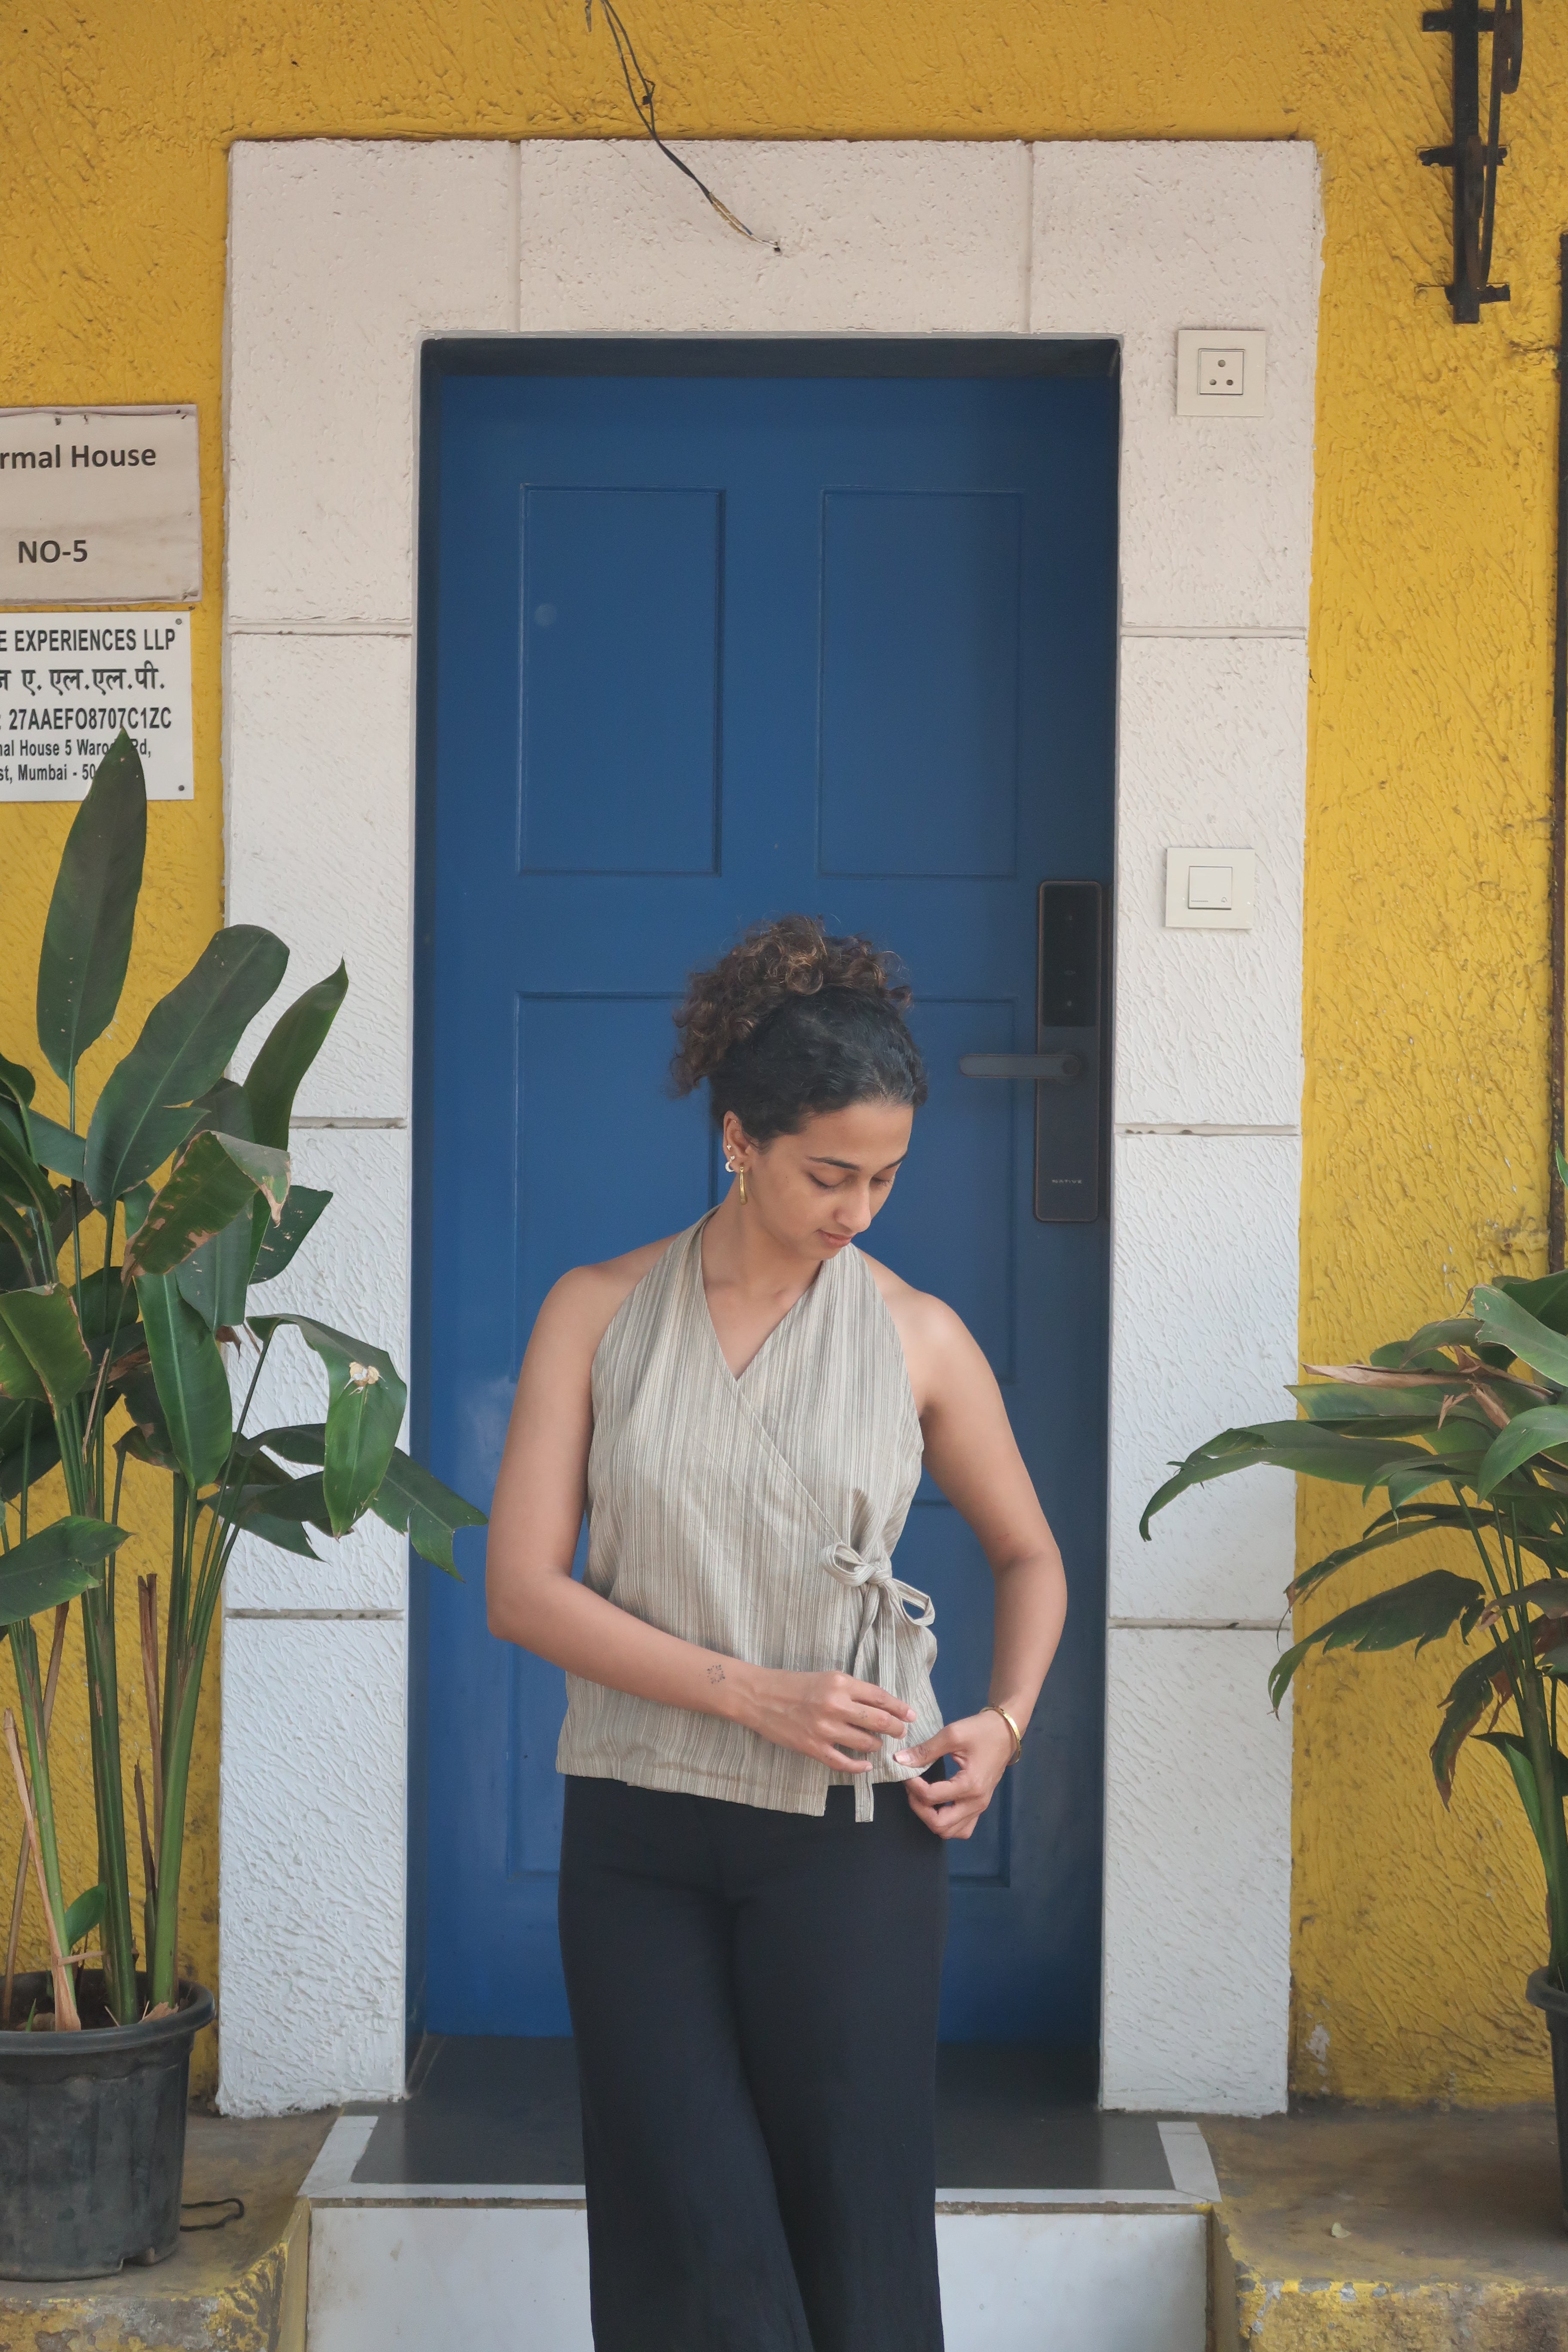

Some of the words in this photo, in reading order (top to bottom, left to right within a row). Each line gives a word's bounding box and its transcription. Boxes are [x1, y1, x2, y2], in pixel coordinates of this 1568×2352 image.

[0, 444, 60, 469] rmal
[71, 445, 156, 467] House
[18, 540, 88, 563] NO-5
[15, 629, 136, 652] EXPERIENCES
[144, 628, 175, 650] LLP
[0, 739, 14, 756] al
[20, 739, 59, 756] House
[65, 739, 72, 756] 5
[18, 764, 67, 781] Mumbai
